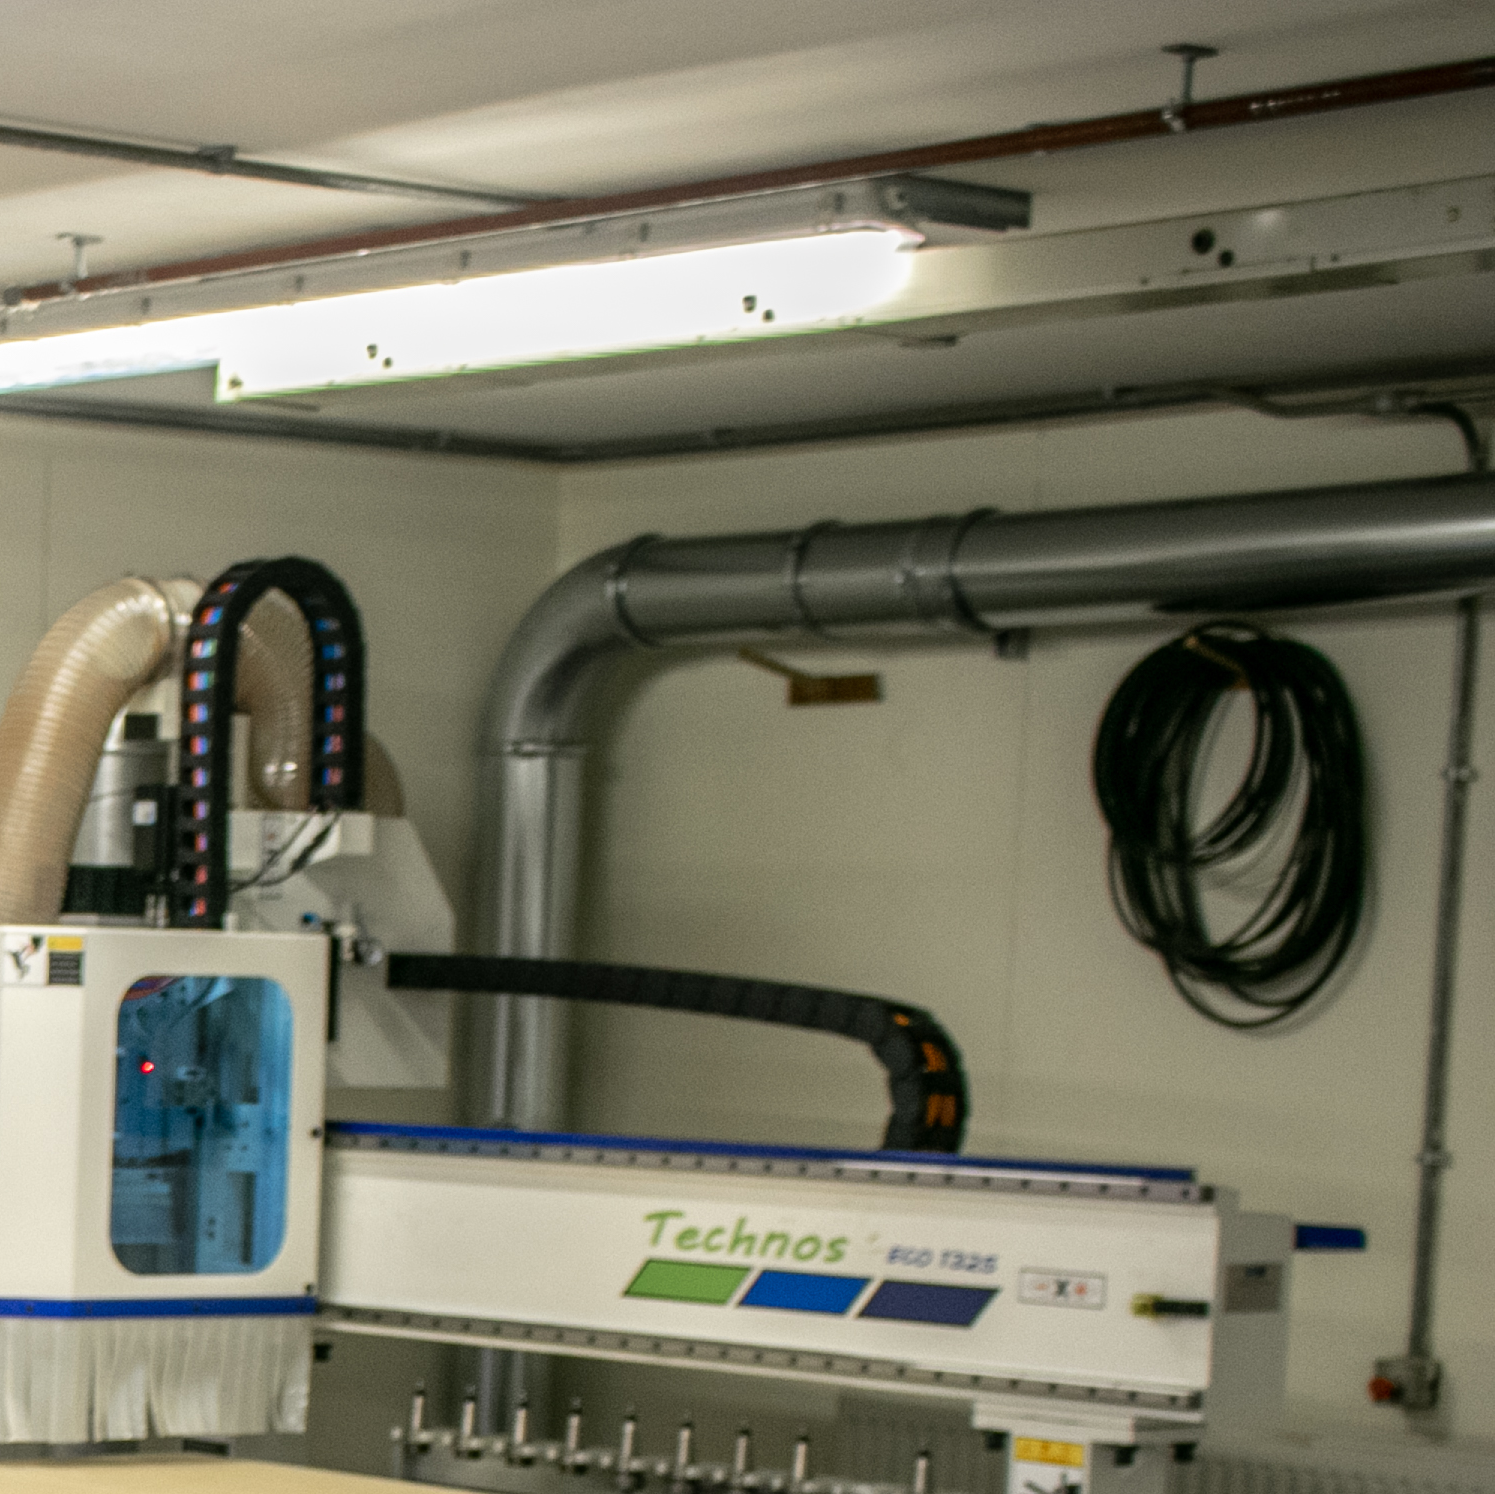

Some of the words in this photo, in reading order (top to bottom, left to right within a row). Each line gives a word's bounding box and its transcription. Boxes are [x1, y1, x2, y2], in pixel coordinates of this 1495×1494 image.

[644, 1210, 848, 1263] Technos
[888, 1245, 933, 1268] ECO
[939, 1249, 998, 1275] 1325
